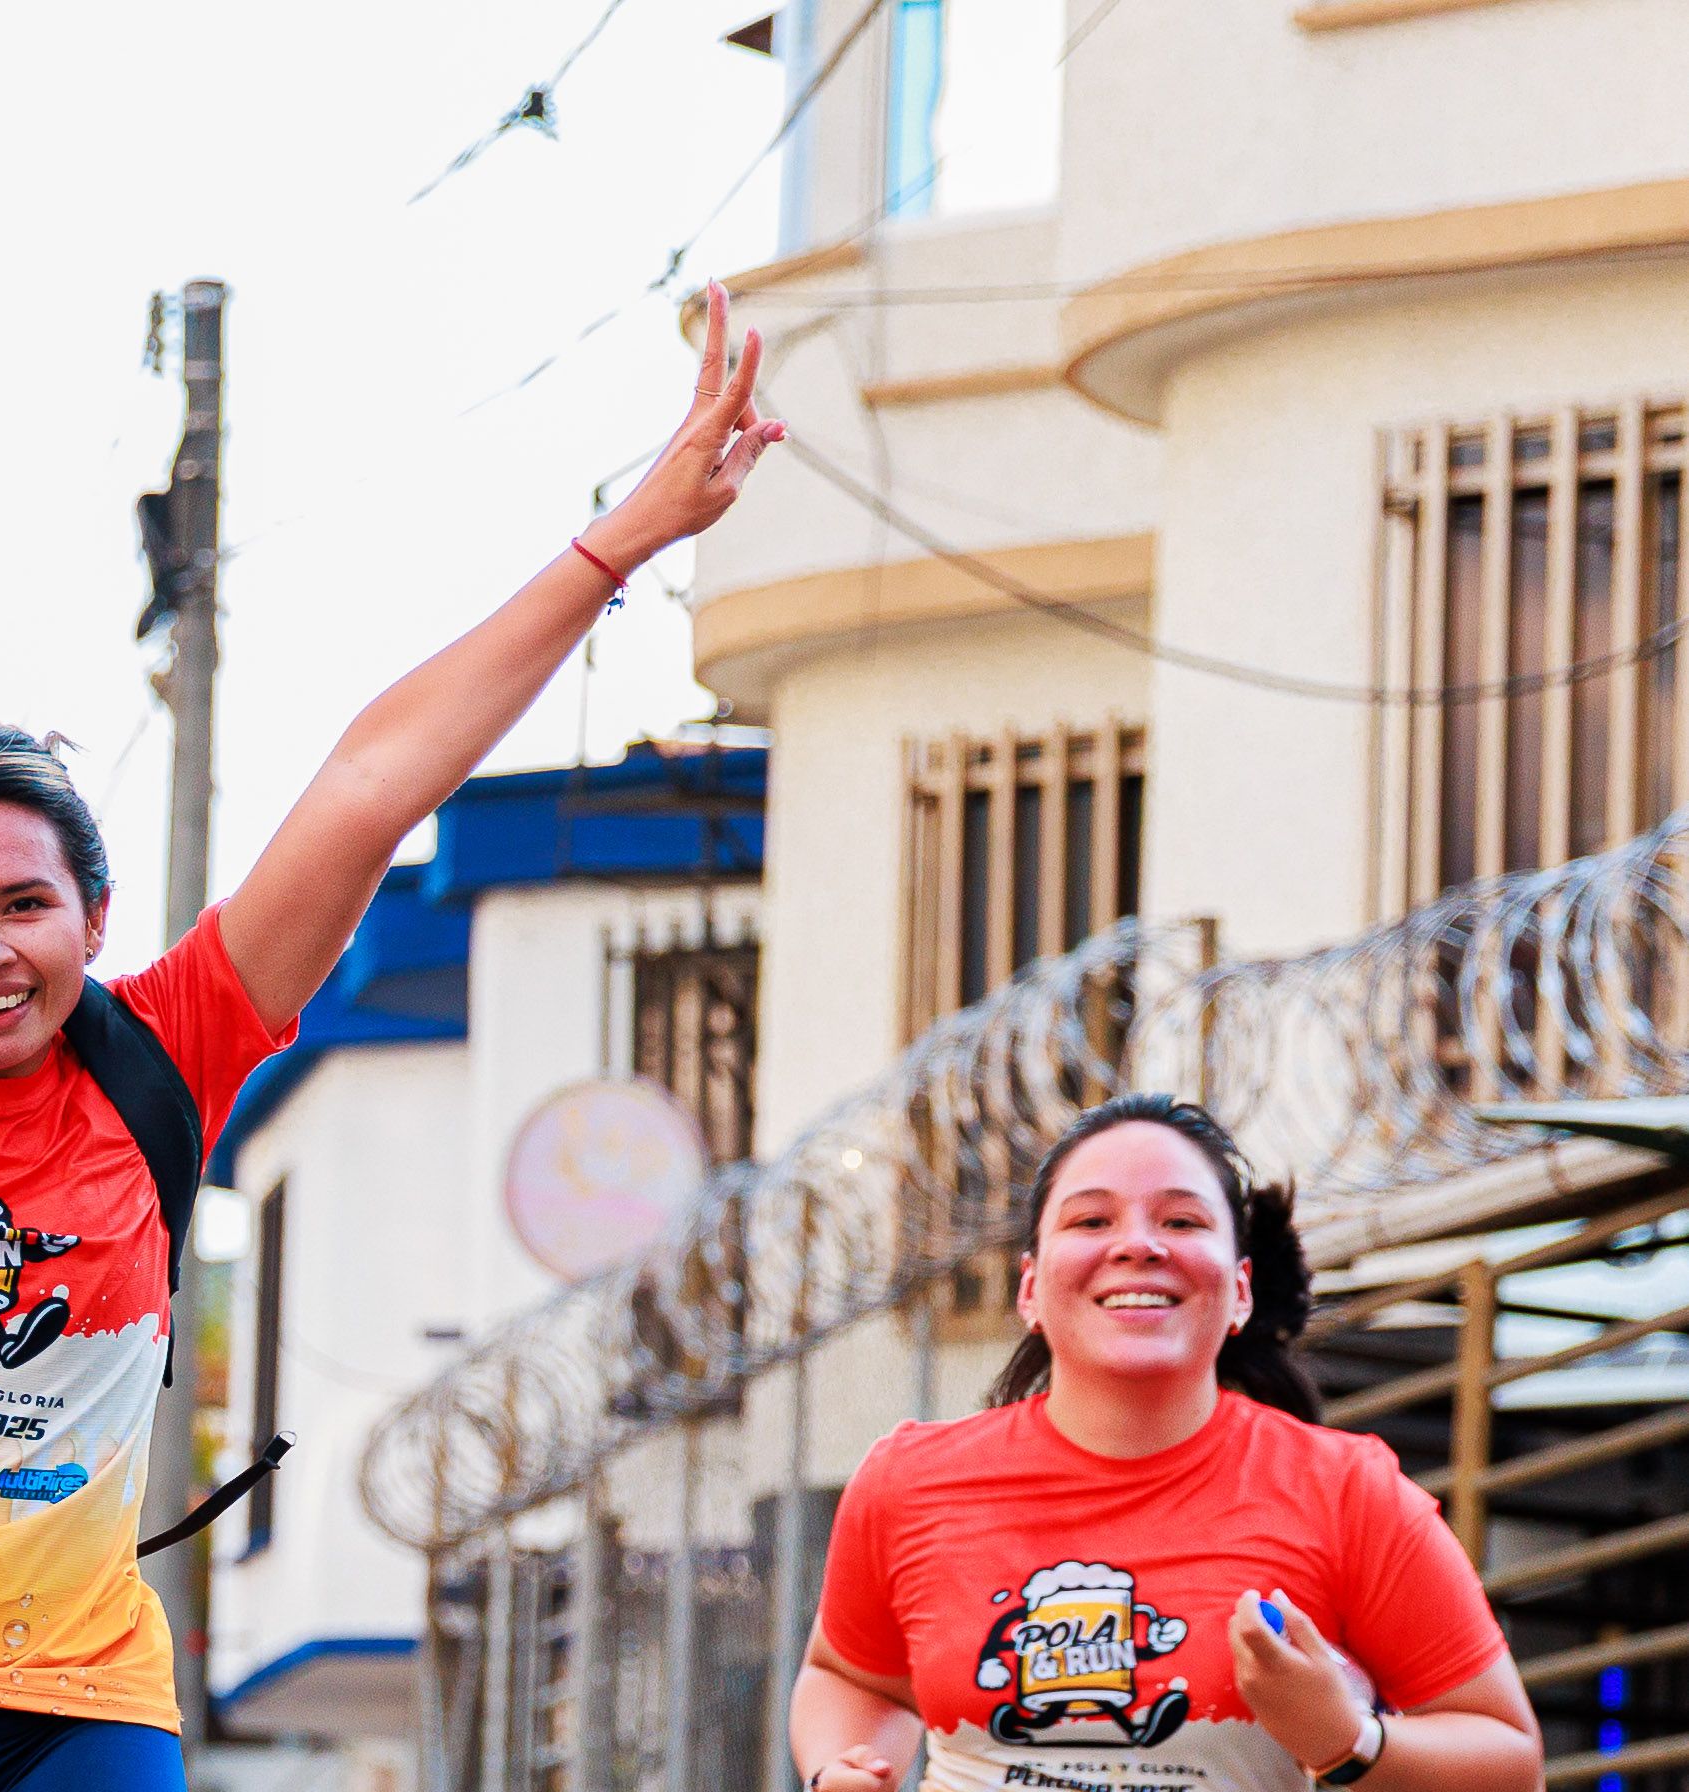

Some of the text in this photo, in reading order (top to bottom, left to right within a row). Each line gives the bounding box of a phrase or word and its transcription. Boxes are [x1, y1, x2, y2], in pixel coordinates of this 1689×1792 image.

[1014, 1612, 1118, 1652] POLA
[1033, 1639, 1137, 1680] & RUN
